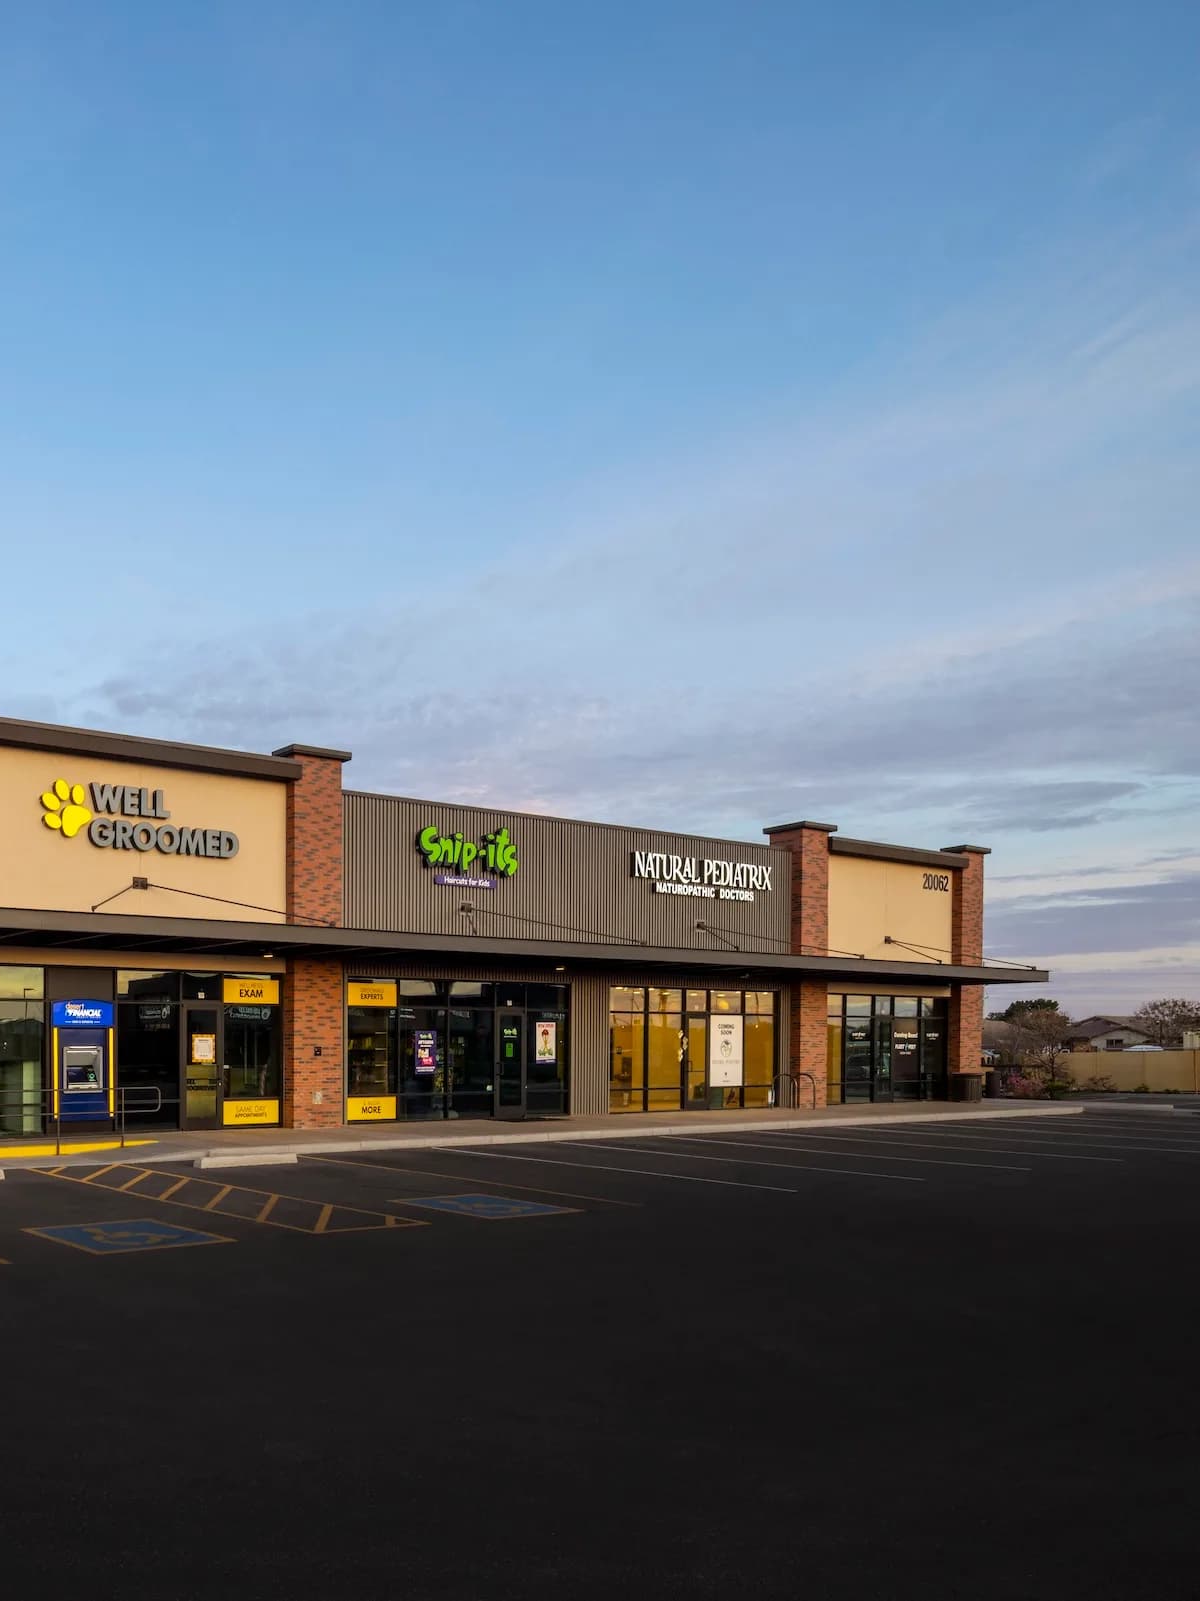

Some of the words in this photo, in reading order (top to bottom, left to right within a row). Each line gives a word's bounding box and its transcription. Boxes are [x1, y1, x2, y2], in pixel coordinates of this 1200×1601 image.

[88, 782, 171, 819] WELL
[88, 817, 240, 859] GROOMED
[634, 851, 701, 884] NATURAL
[703, 859, 772, 891] PEDIATRIX
[444, 876, 468, 886] Haircuts
[468, 877, 478, 886] for
[478, 879, 491, 887] Kids
[922, 872, 950, 892] 20062
[655, 883, 716, 898] NATUROPATHIC
[719, 889, 755, 902] DOCTORS
[239, 989, 264, 998] EXAM
[361, 1106, 382, 1114] MORE
